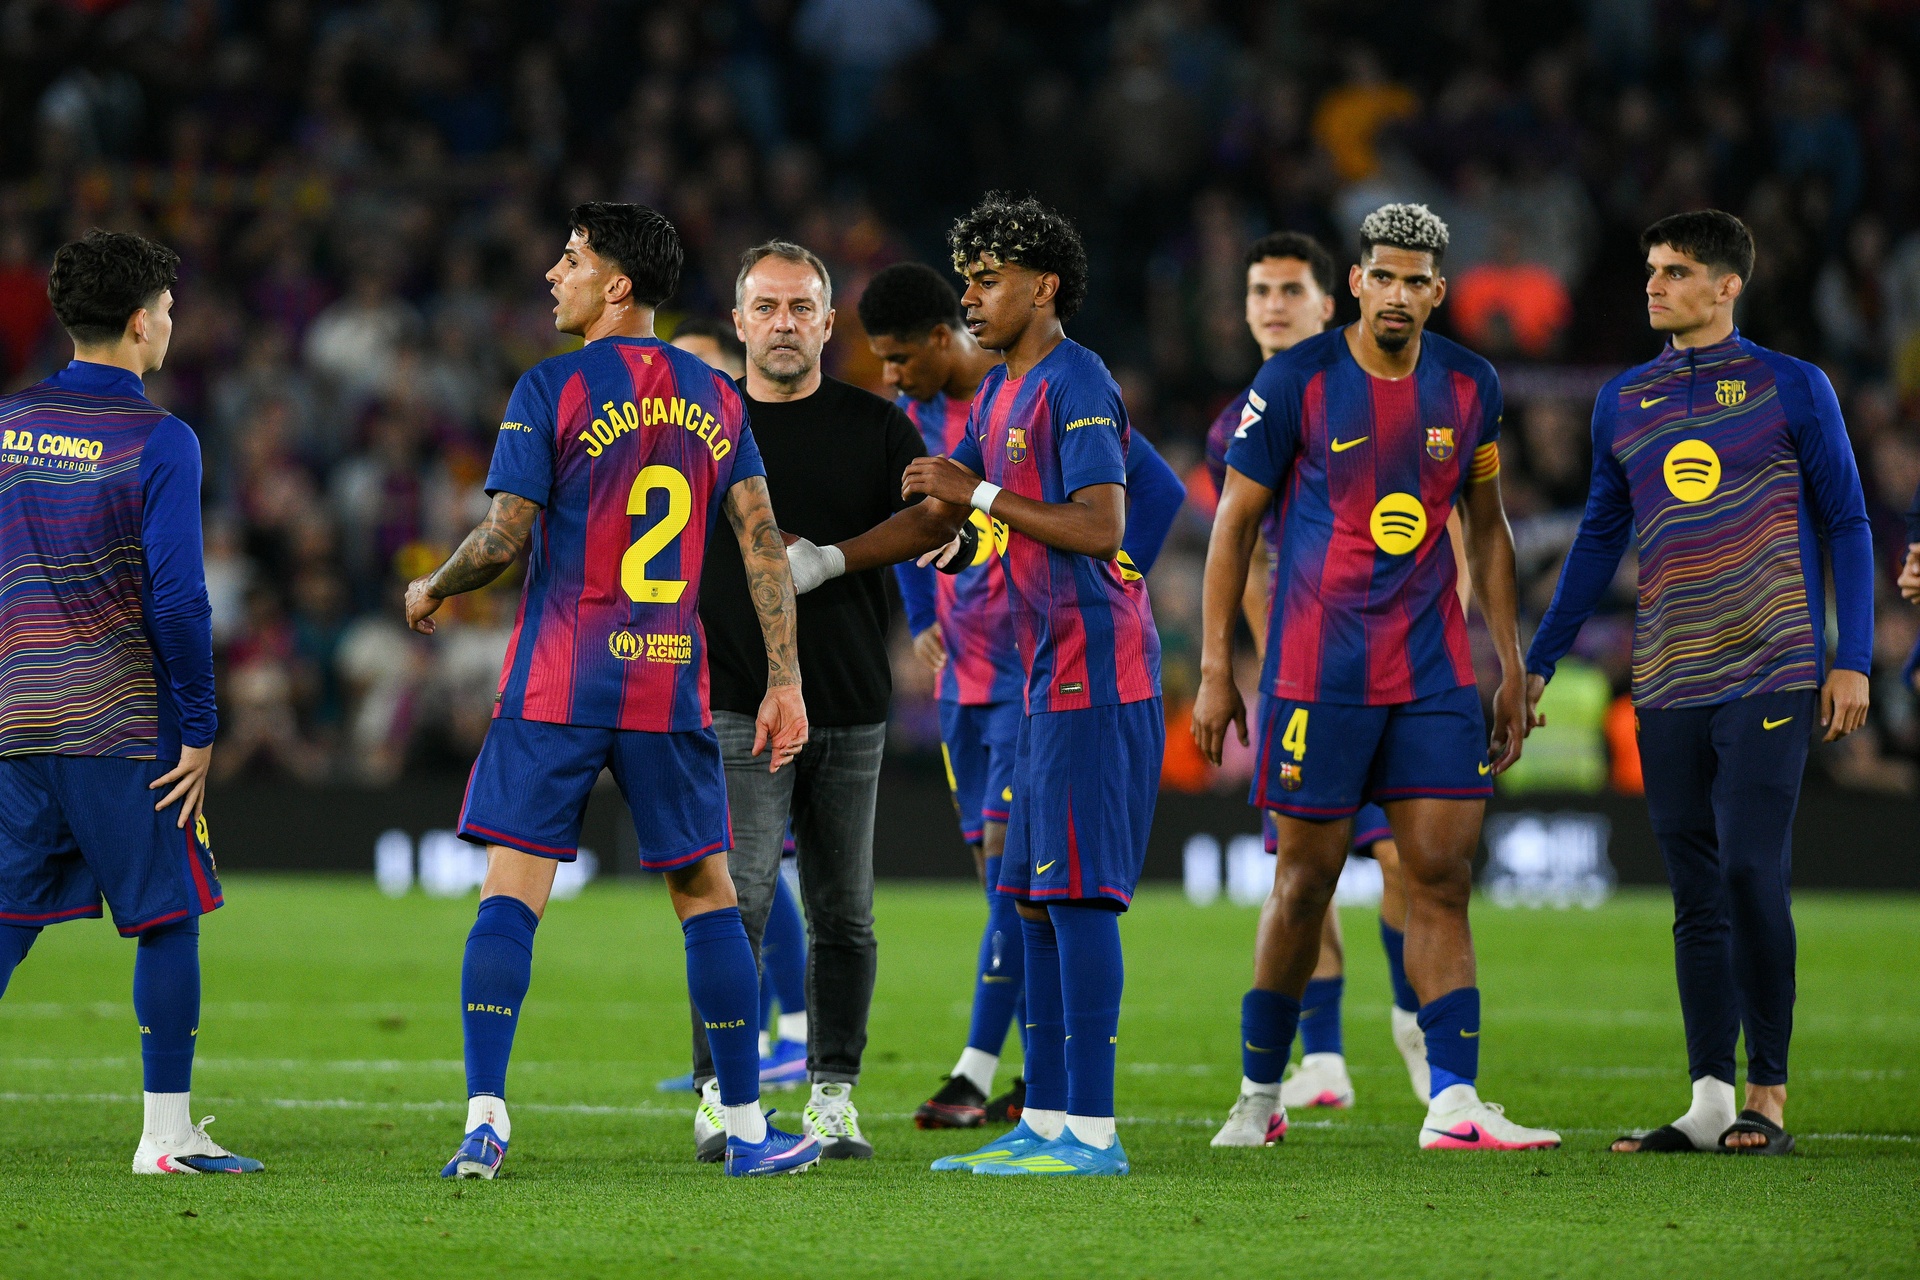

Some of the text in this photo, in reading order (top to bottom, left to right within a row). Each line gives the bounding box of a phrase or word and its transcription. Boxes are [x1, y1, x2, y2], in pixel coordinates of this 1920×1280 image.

[523, 425, 533, 433] tv
[578, 396, 732, 462] JOÃO CANCELO
[1066, 416, 1111, 432] AMBILIGHT
[2, 429, 104, 461] R.D. CONGO
[1, 453, 98, 473] CŒUR DE L'AFRIQUE
[619, 464, 693, 604] 2
[646, 633, 692, 648] UNHCR
[645, 646, 692, 659] ACNUR
[1281, 707, 1309, 762] 4
[467, 1003, 512, 1016] BARÇA
[704, 1018, 746, 1029] BARÇA
